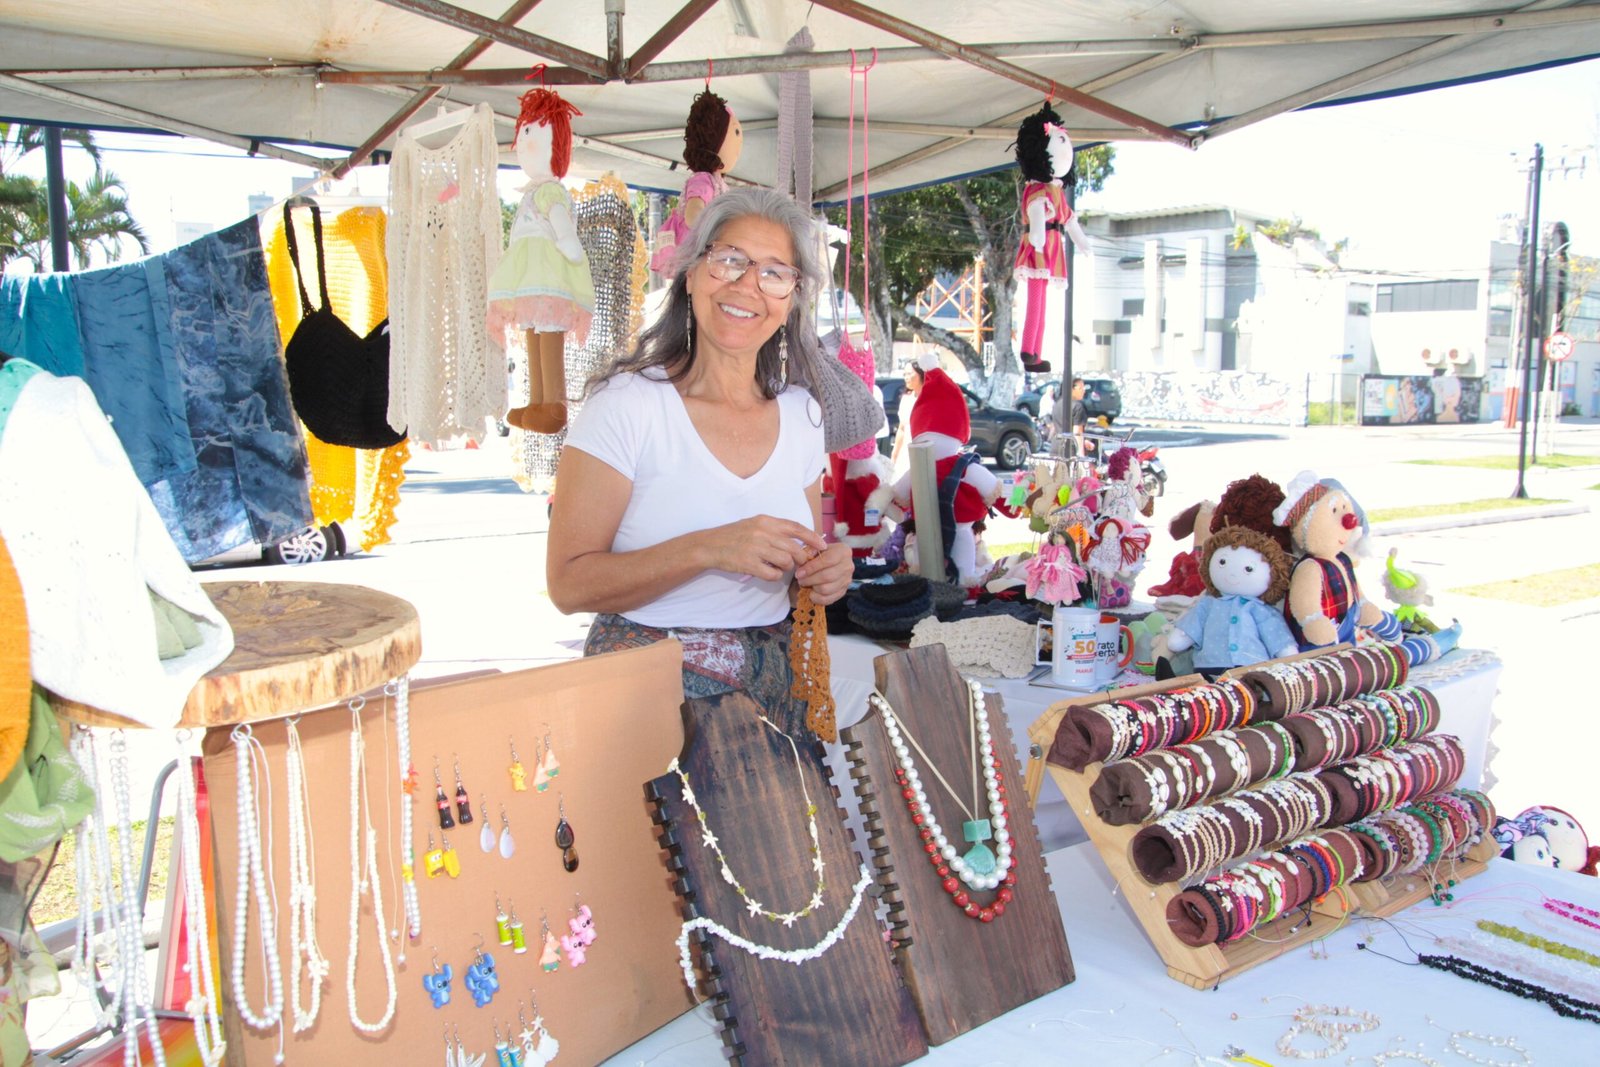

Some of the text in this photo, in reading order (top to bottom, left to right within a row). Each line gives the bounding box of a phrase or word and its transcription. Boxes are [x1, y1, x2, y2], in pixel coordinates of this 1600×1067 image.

[1075, 640, 1095, 654] 50
[1097, 641, 1115, 650] rato
[1098, 649, 1116, 657] erto
